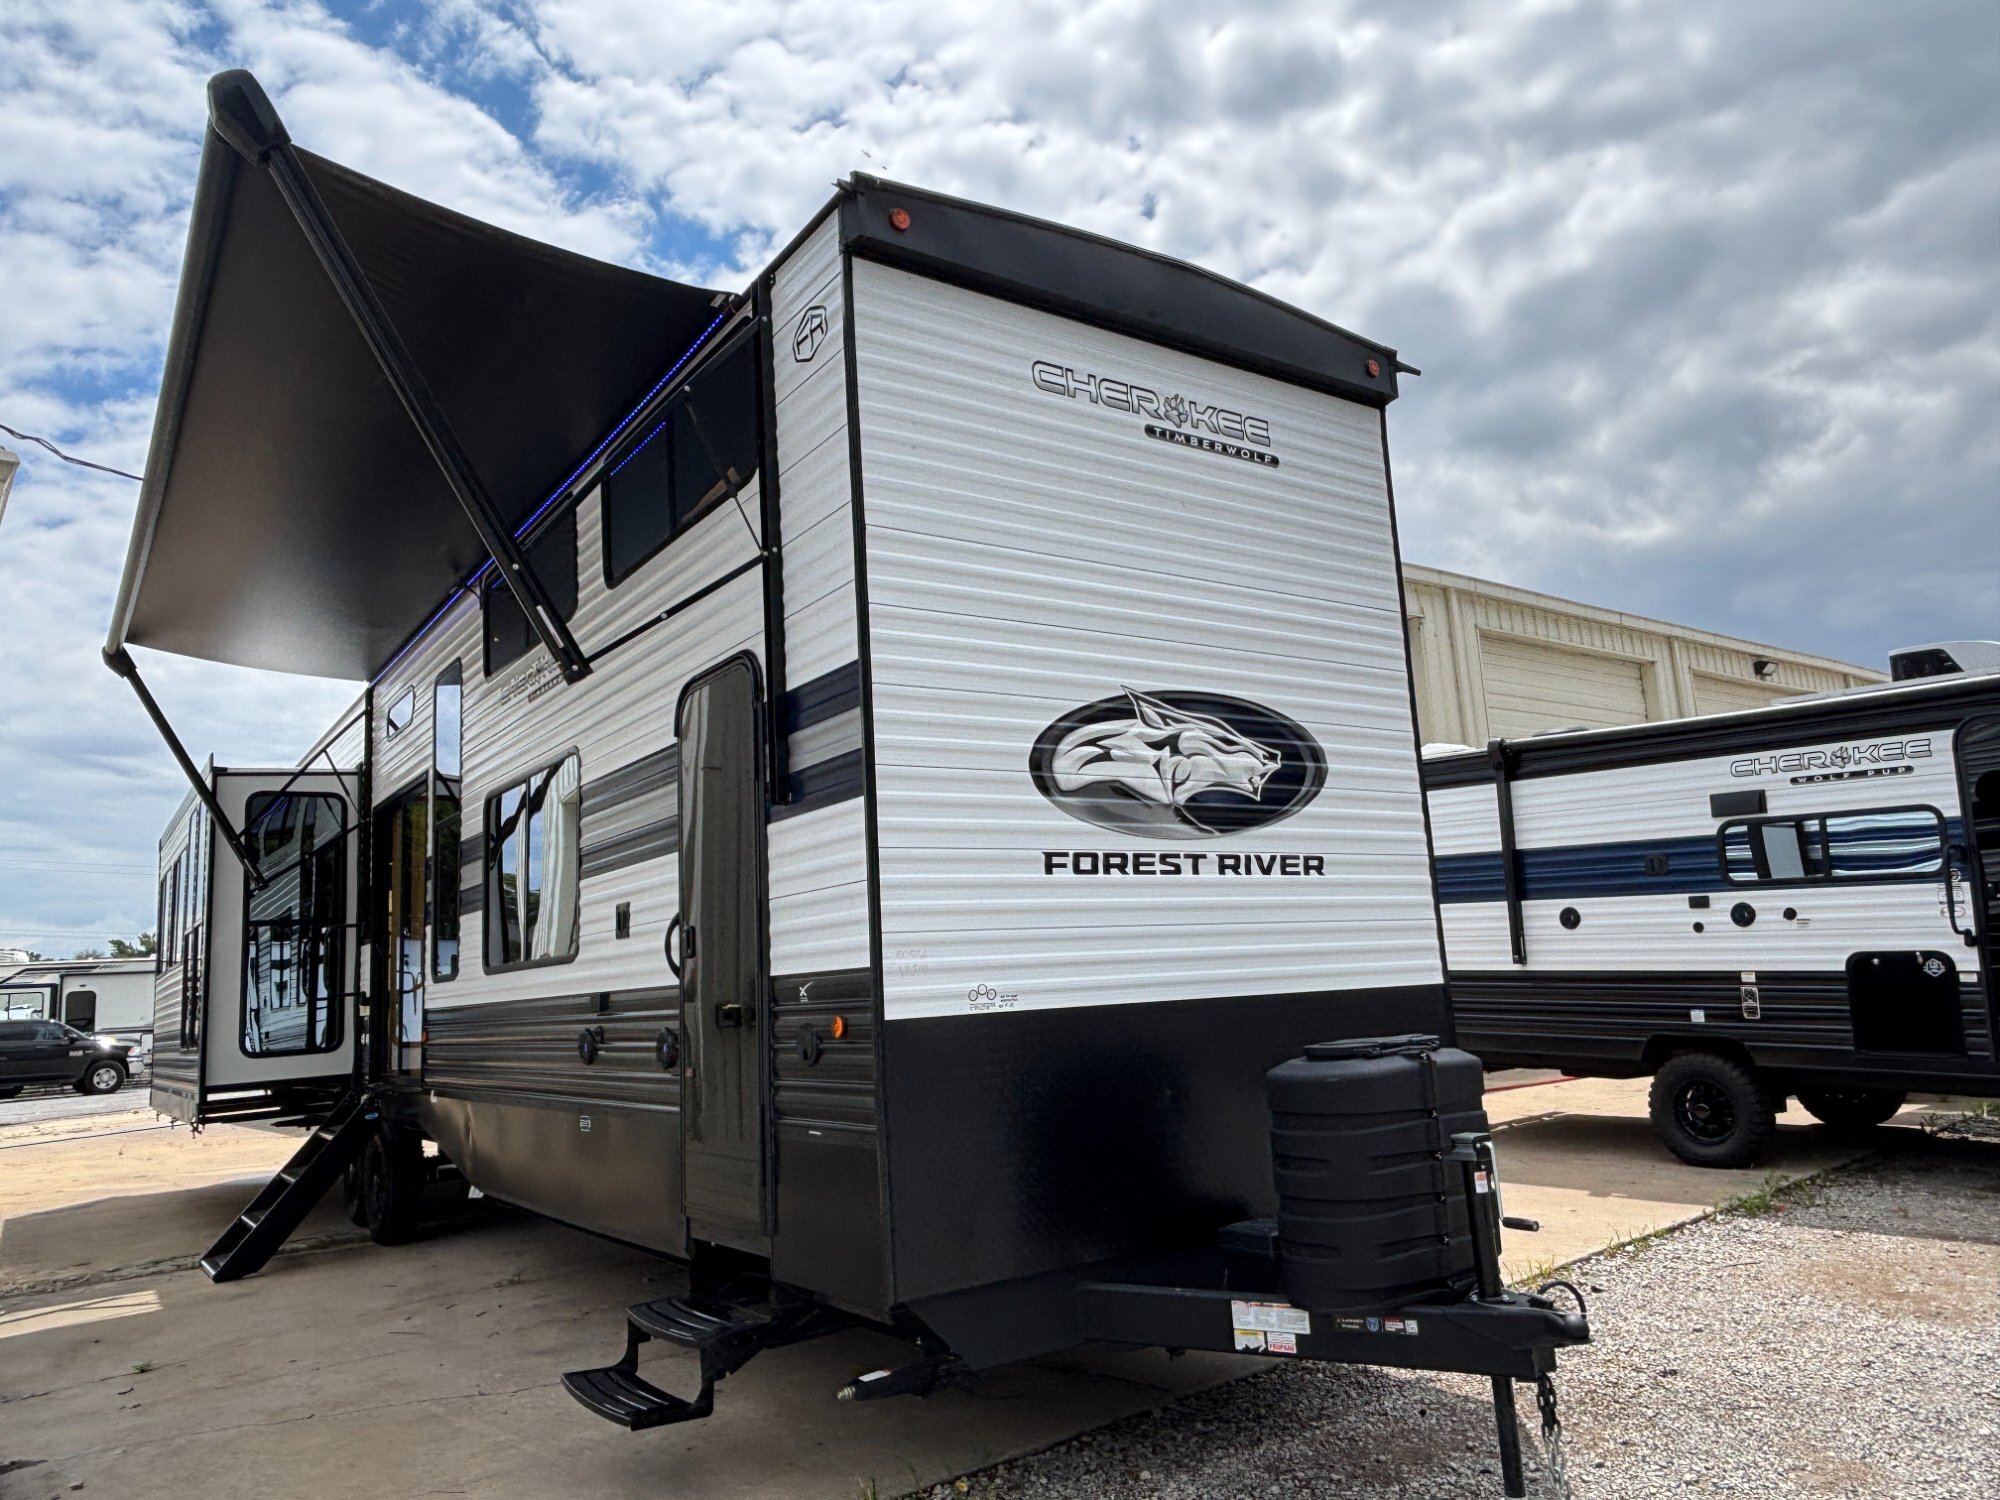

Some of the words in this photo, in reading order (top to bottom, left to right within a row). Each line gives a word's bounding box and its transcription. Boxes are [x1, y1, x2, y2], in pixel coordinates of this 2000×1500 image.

[1153, 426, 1273, 464] TIMBERWOLF
[1796, 772, 1850, 784] WOLF
[1867, 766, 1907, 777] PUP
[1042, 851, 1207, 876] FOREST
[1216, 853, 1326, 876] RIVER
